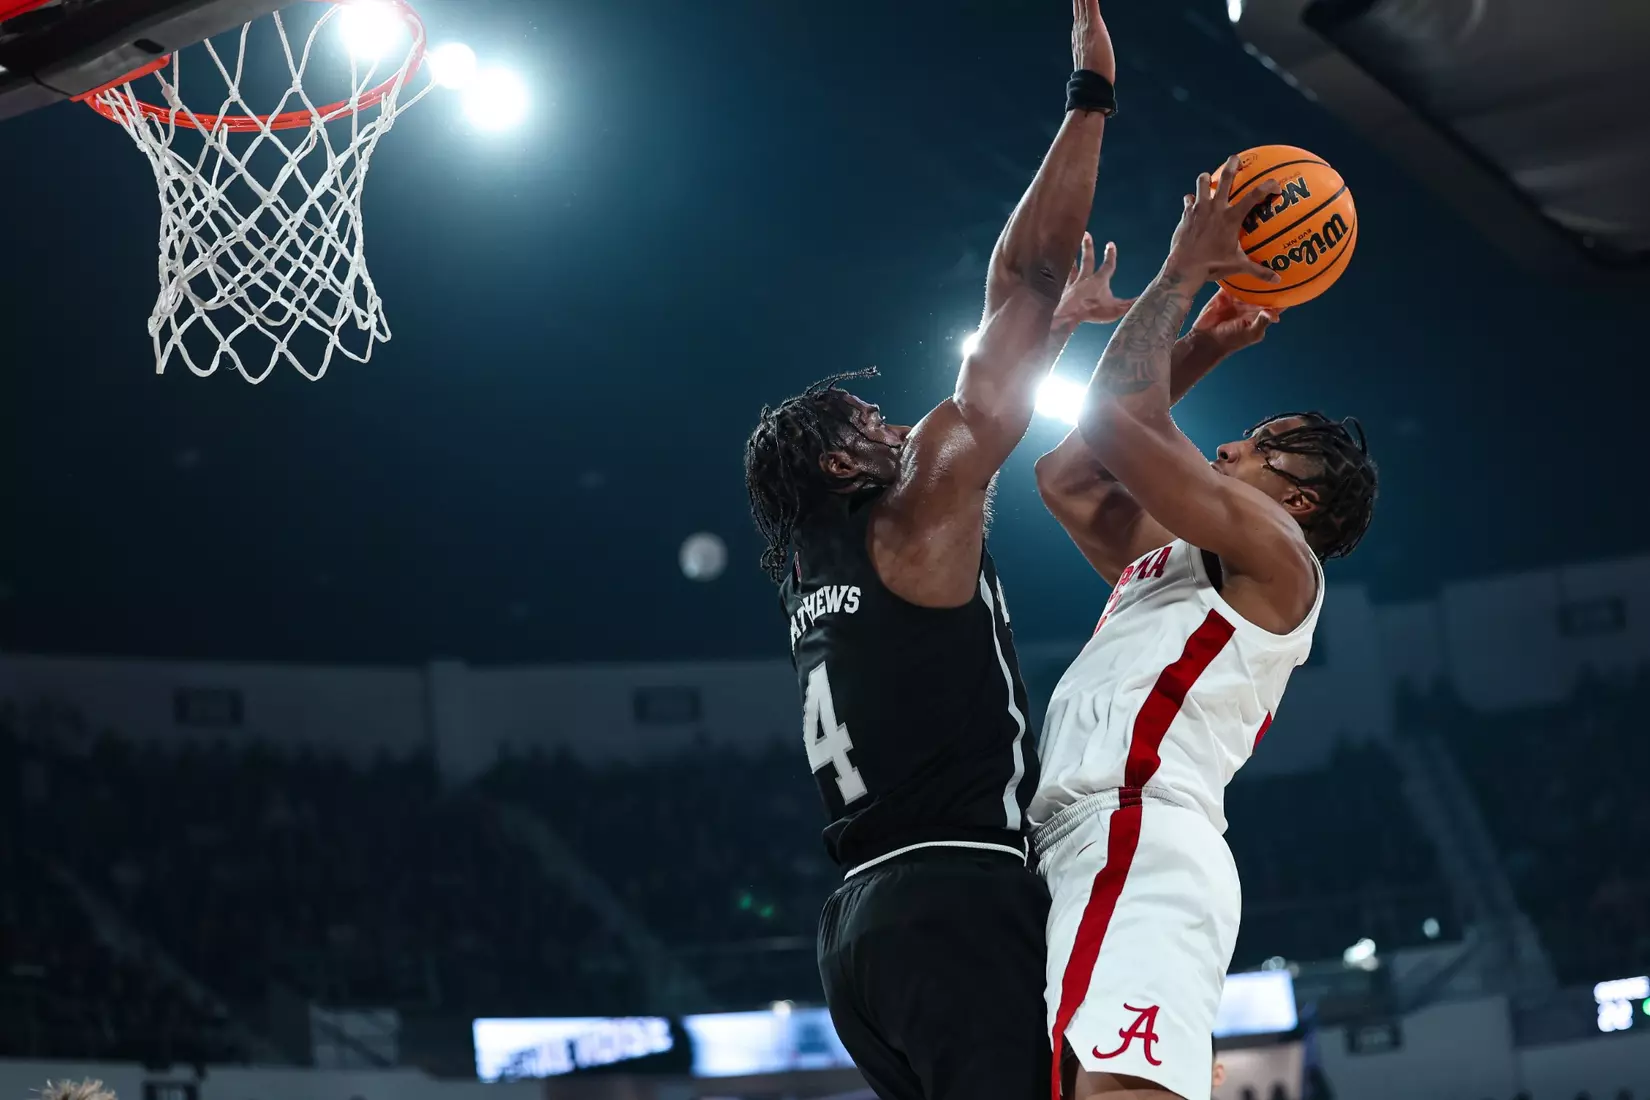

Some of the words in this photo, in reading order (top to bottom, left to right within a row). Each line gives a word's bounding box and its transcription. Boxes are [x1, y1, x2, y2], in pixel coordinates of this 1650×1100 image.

[1283, 238, 1297, 250] NXT
[1298, 228, 1312, 241] EVO
[803, 661, 868, 805] 4
[1092, 1003, 1162, 1066] A
